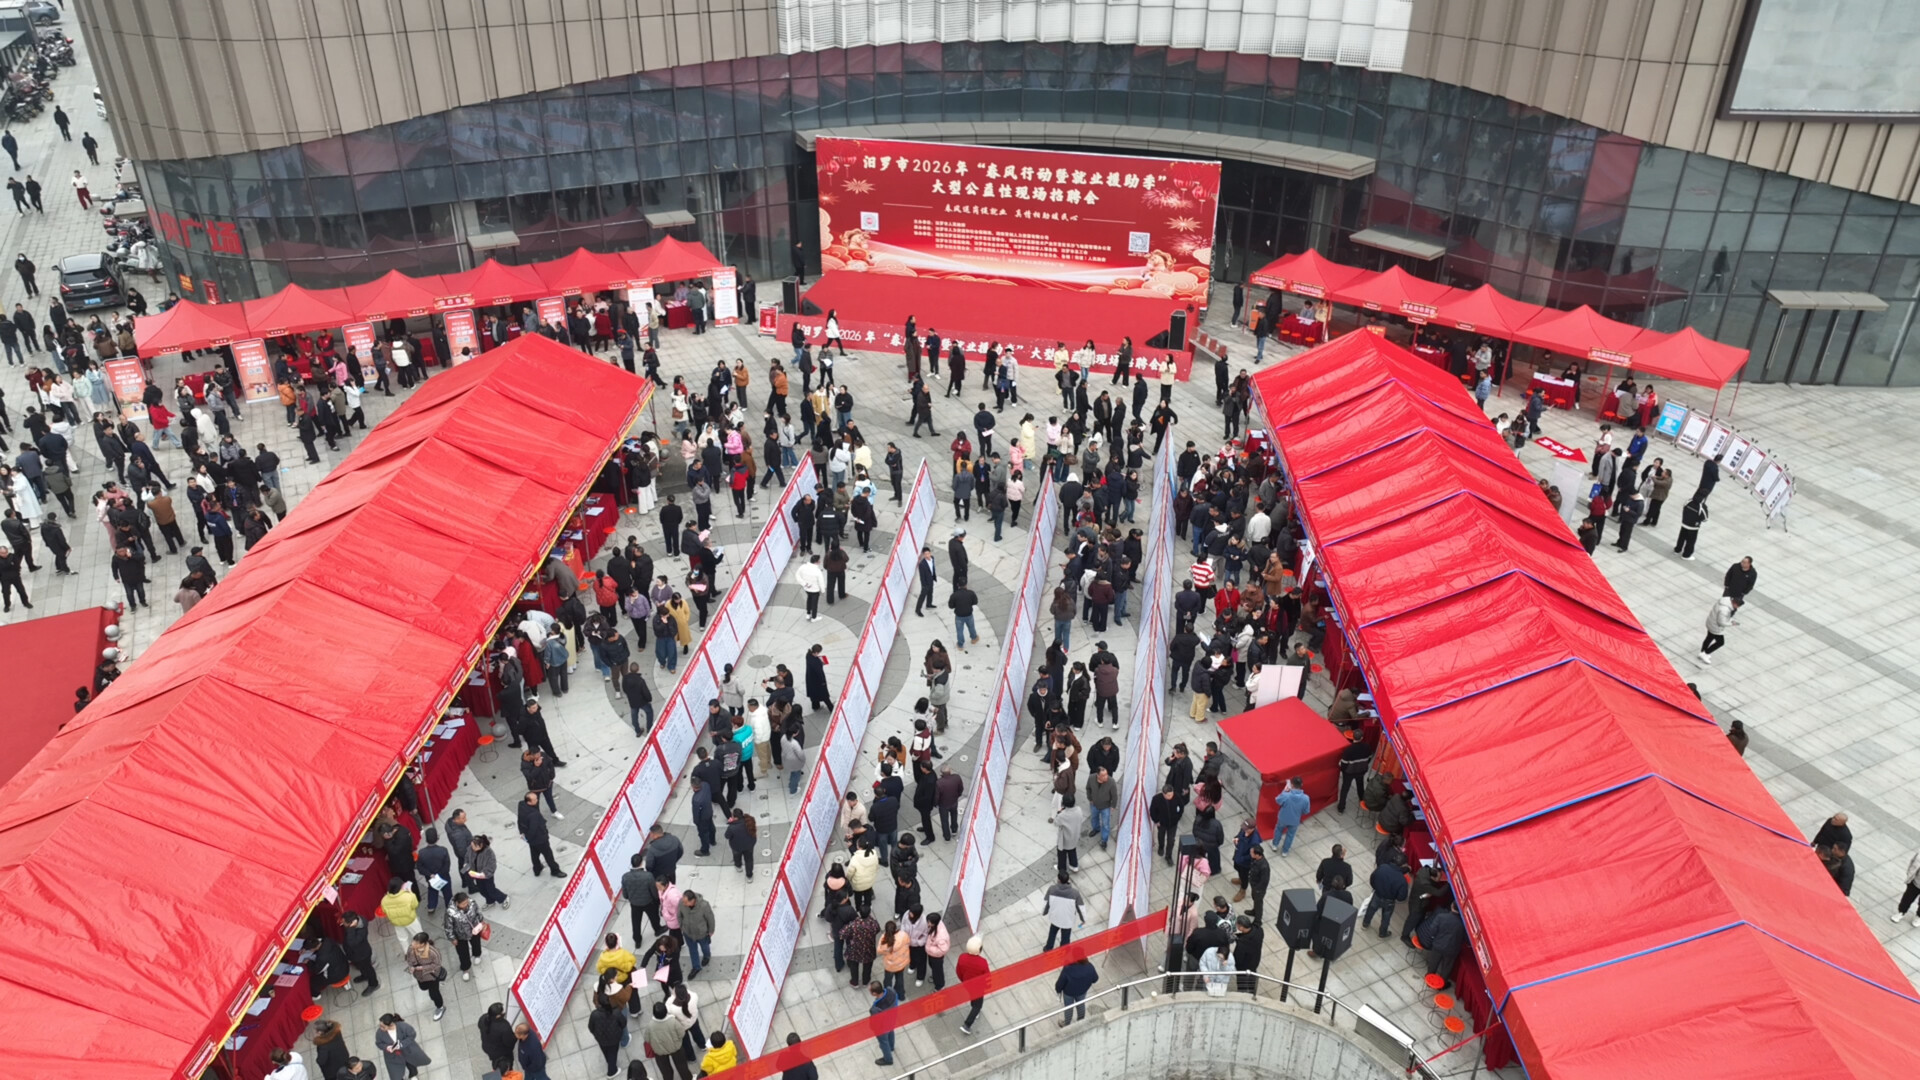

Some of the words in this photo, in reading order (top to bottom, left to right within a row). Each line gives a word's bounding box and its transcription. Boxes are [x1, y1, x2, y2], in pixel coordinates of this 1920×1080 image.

[931, 178, 1100, 205] 大型公益性现场招聘会
